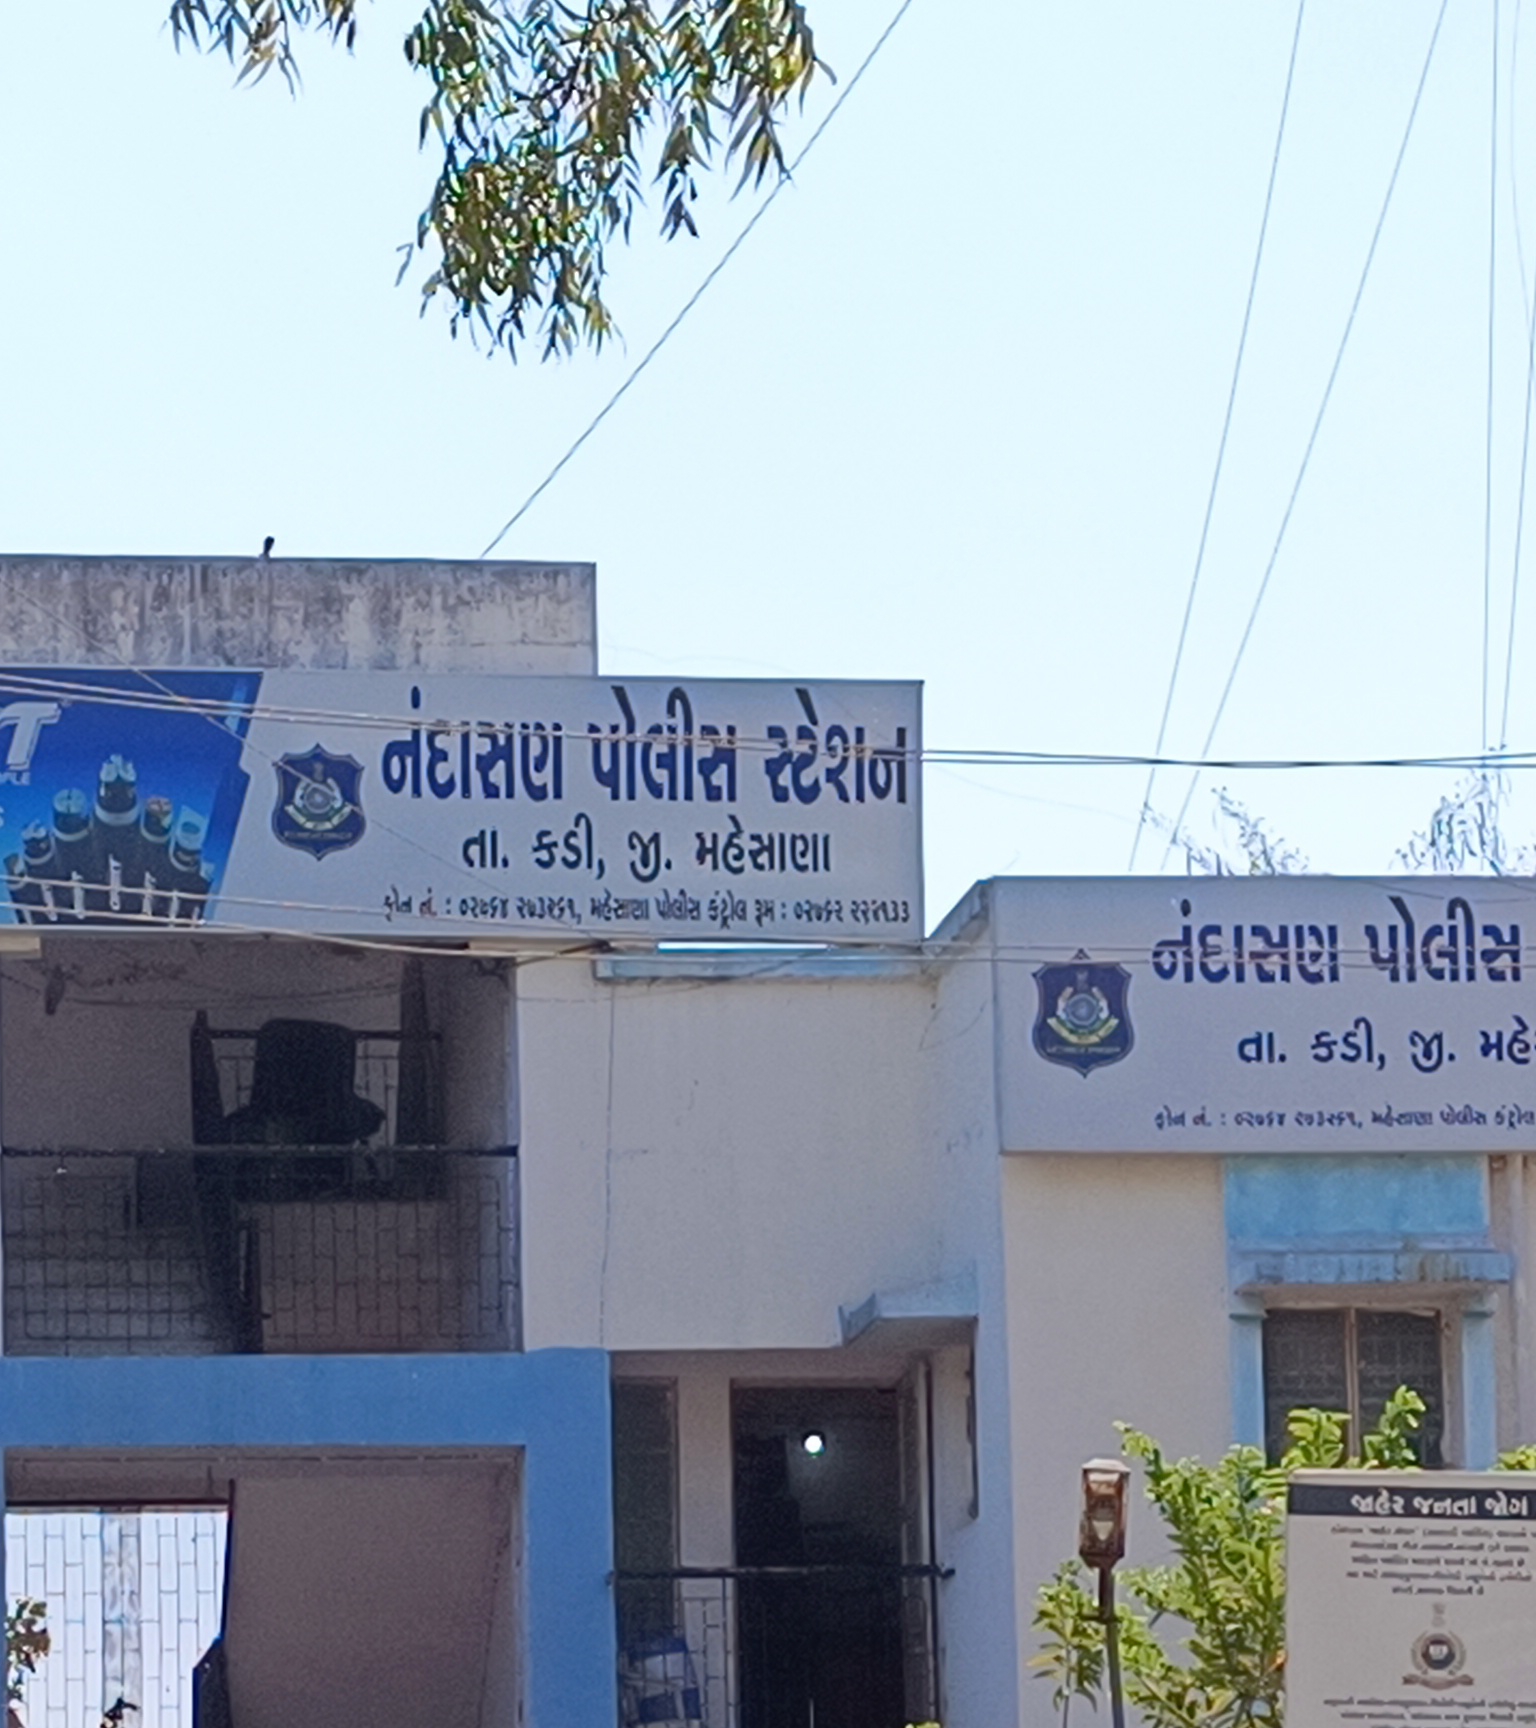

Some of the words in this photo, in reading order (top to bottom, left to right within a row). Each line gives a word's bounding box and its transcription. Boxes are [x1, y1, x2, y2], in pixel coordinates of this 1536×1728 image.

[381, 686, 564, 799] નંદાસણ
[587, 685, 737, 801] પોલીસ
[764, 688, 907, 803] સ્ટેશન
[462, 827, 509, 870] તા.
[532, 813, 605, 880] કડી,
[628, 831, 671, 882] જી.
[694, 814, 832, 875] મહેસાણા
[590, 888, 650, 921] મહેસાણા
[655, 888, 701, 921] પોલીસ
[1151, 897, 1340, 984] નંદાસણ
[1364, 895, 1522, 983] પોલીસ
[1237, 1032, 1287, 1064] તા.
[1310, 1016, 1386, 1071] કડી,
[1409, 1030, 1456, 1073] જી.
[1371, 1102, 1433, 1128] મહેસાણા
[1439, 1103, 1488, 1127] પોલીસ
[1350, 1488, 1405, 1516] જાહેર
[1413, 1493, 1477, 1516] જનતા
[1485, 1489, 1528, 1516] જોગ
